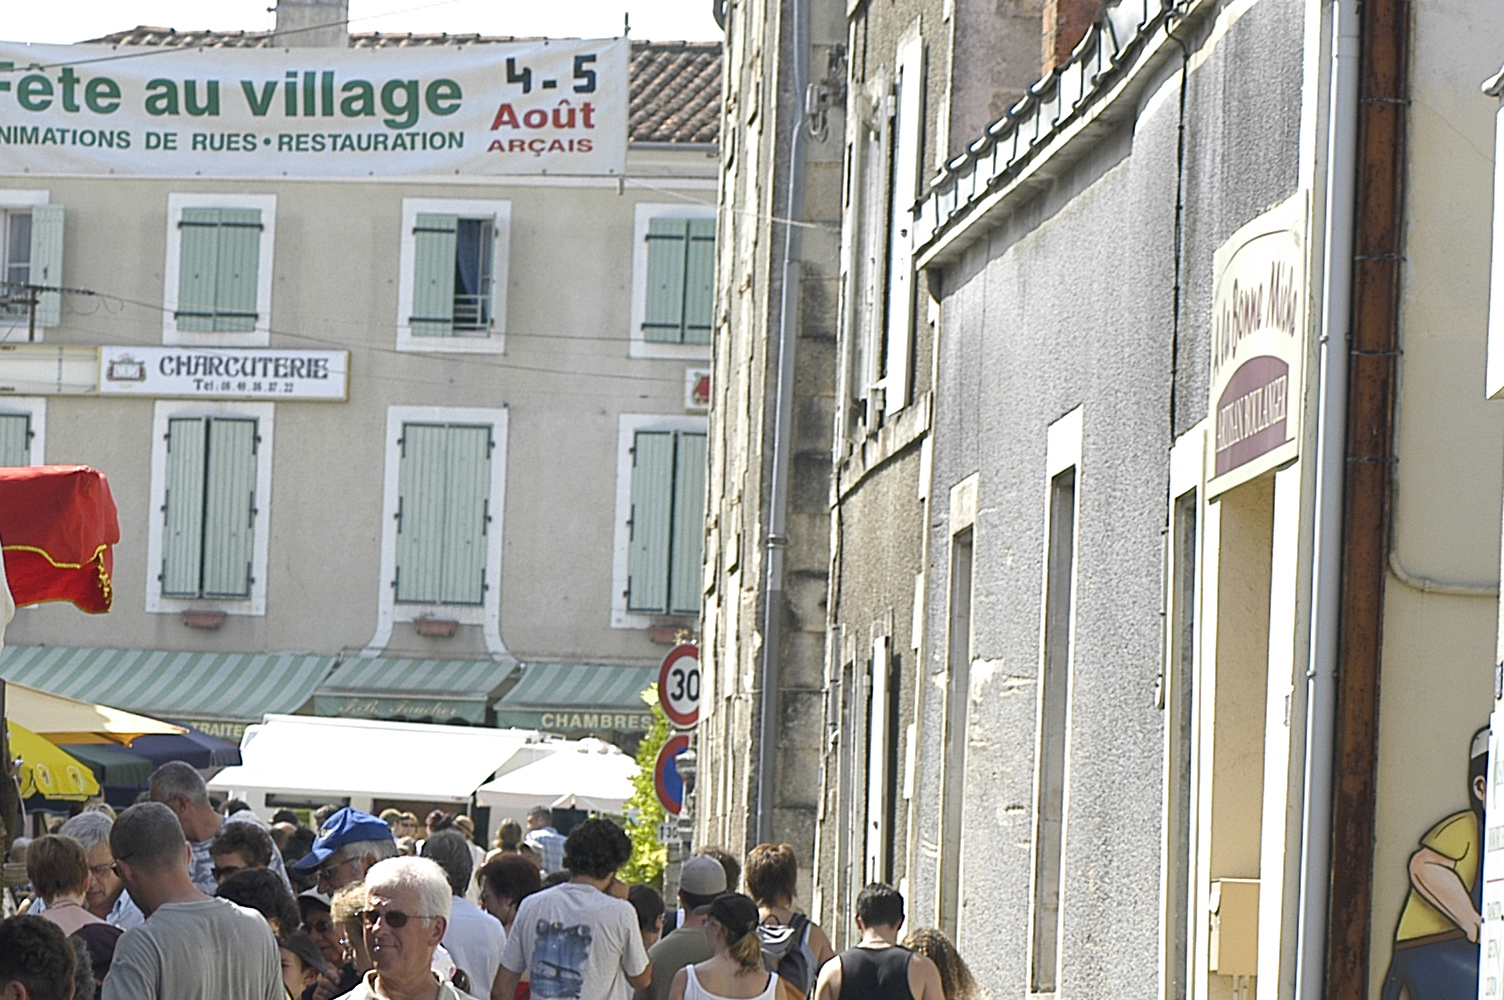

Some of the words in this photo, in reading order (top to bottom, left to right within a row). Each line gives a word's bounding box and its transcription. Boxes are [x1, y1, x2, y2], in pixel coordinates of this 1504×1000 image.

[145, 79, 220, 116] au
[241, 71, 463, 129] village
[490, 99, 595, 130] Août
[145, 132, 177, 150] DE
[487, 138, 593, 157] ARÇAIS
[159, 355, 328, 380] CHARCUTERIE
[670, 668, 701, 702] 30
[190, 721, 243, 738] TRAITE
[541, 713, 653, 730] CHAMBRES
